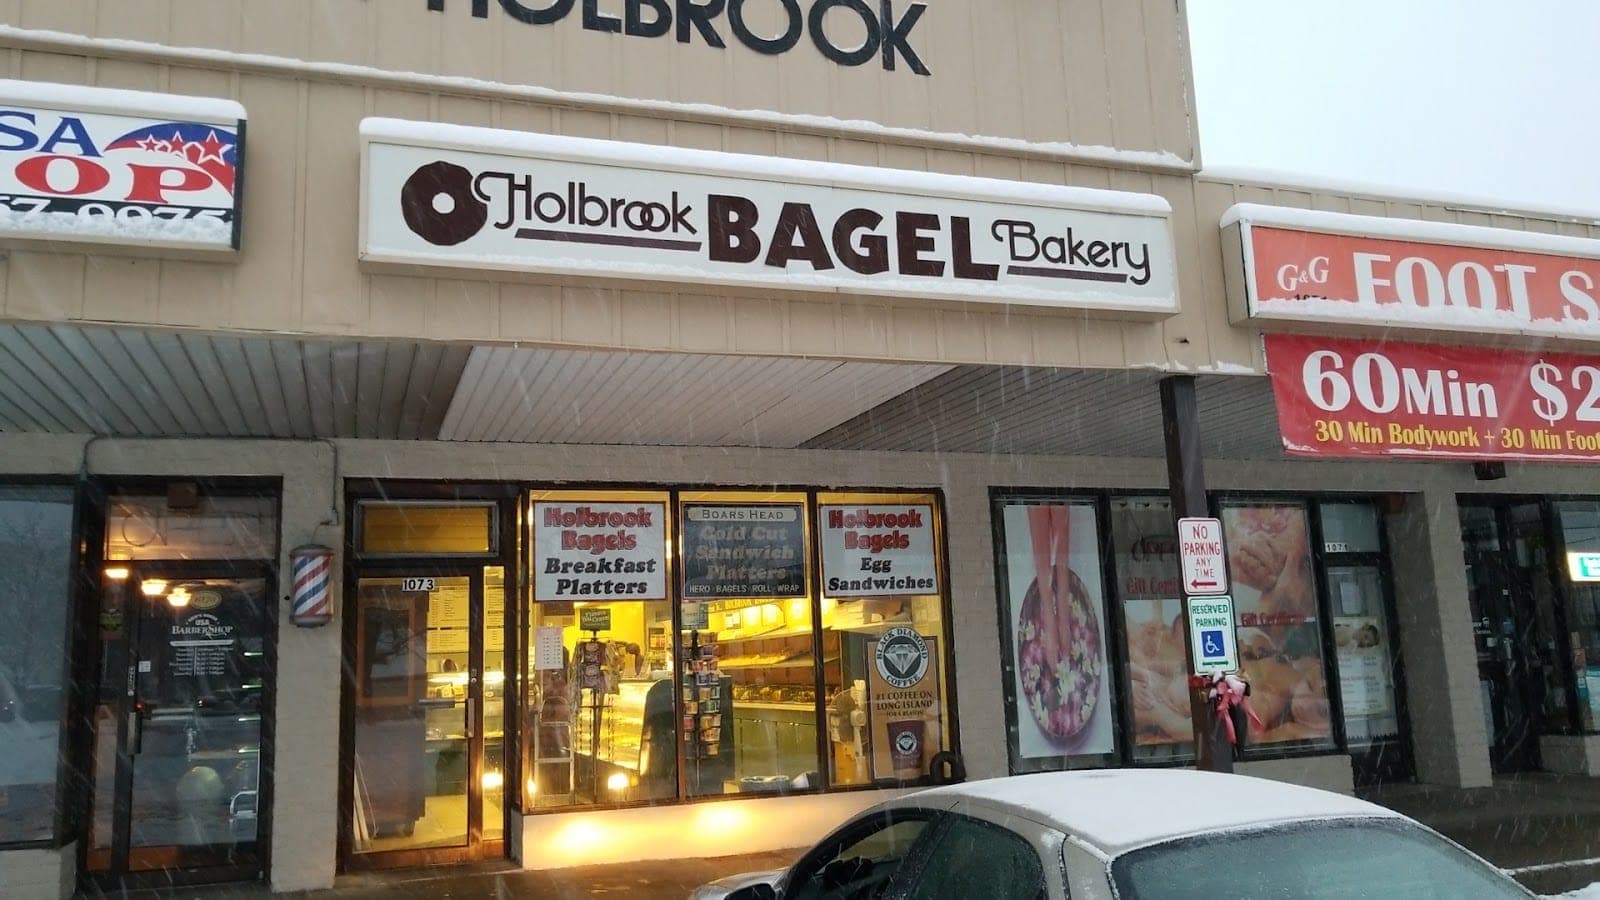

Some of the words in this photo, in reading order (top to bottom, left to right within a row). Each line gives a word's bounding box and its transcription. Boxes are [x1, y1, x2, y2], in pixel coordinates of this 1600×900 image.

[15, 155, 213, 203] OP
[474, 171, 698, 235] Holbrook
[707, 194, 999, 281] BAGEL
[992, 218, 1151, 285] Bakery
[1277, 256, 1329, 291] G&G
[1353, 251, 1536, 322] FOOT
[1315, 420, 1343, 442] 30
[1348, 421, 1383, 443] Min
[1389, 424, 1480, 448] Bodywork
[1500, 428, 1525, 449] 30
[1530, 428, 1561, 450] Min
[544, 506, 653, 529] Holbrook
[702, 509, 744, 519] BOARS
[749, 509, 784, 519] HEAD
[828, 509, 922, 529] Holbrook
[1192, 525, 1208, 540] NO
[561, 529, 637, 555] Bagels
[844, 530, 910, 553] Bagels
[1184, 542, 1221, 556] PARKING
[544, 557, 656, 576] Breakfast
[860, 556, 892, 573] Egg
[1196, 559, 1211, 567] ANY
[1195, 568, 1214, 578] TIME
[403, 578, 434, 590] 1073
[555, 578, 648, 596] Platters
[689, 584, 711, 593] HERO
[716, 584, 747, 593] BAGELS
[752, 583, 771, 592] ROLL
[777, 583, 800, 592] WRAP
[828, 576, 934, 592] Sandwiches
[1192, 604, 1228, 615] RESERVED
[1195, 618, 1227, 628] PARKING
[876, 702, 901, 711] LONG
[902, 700, 933, 709] ISLAND
